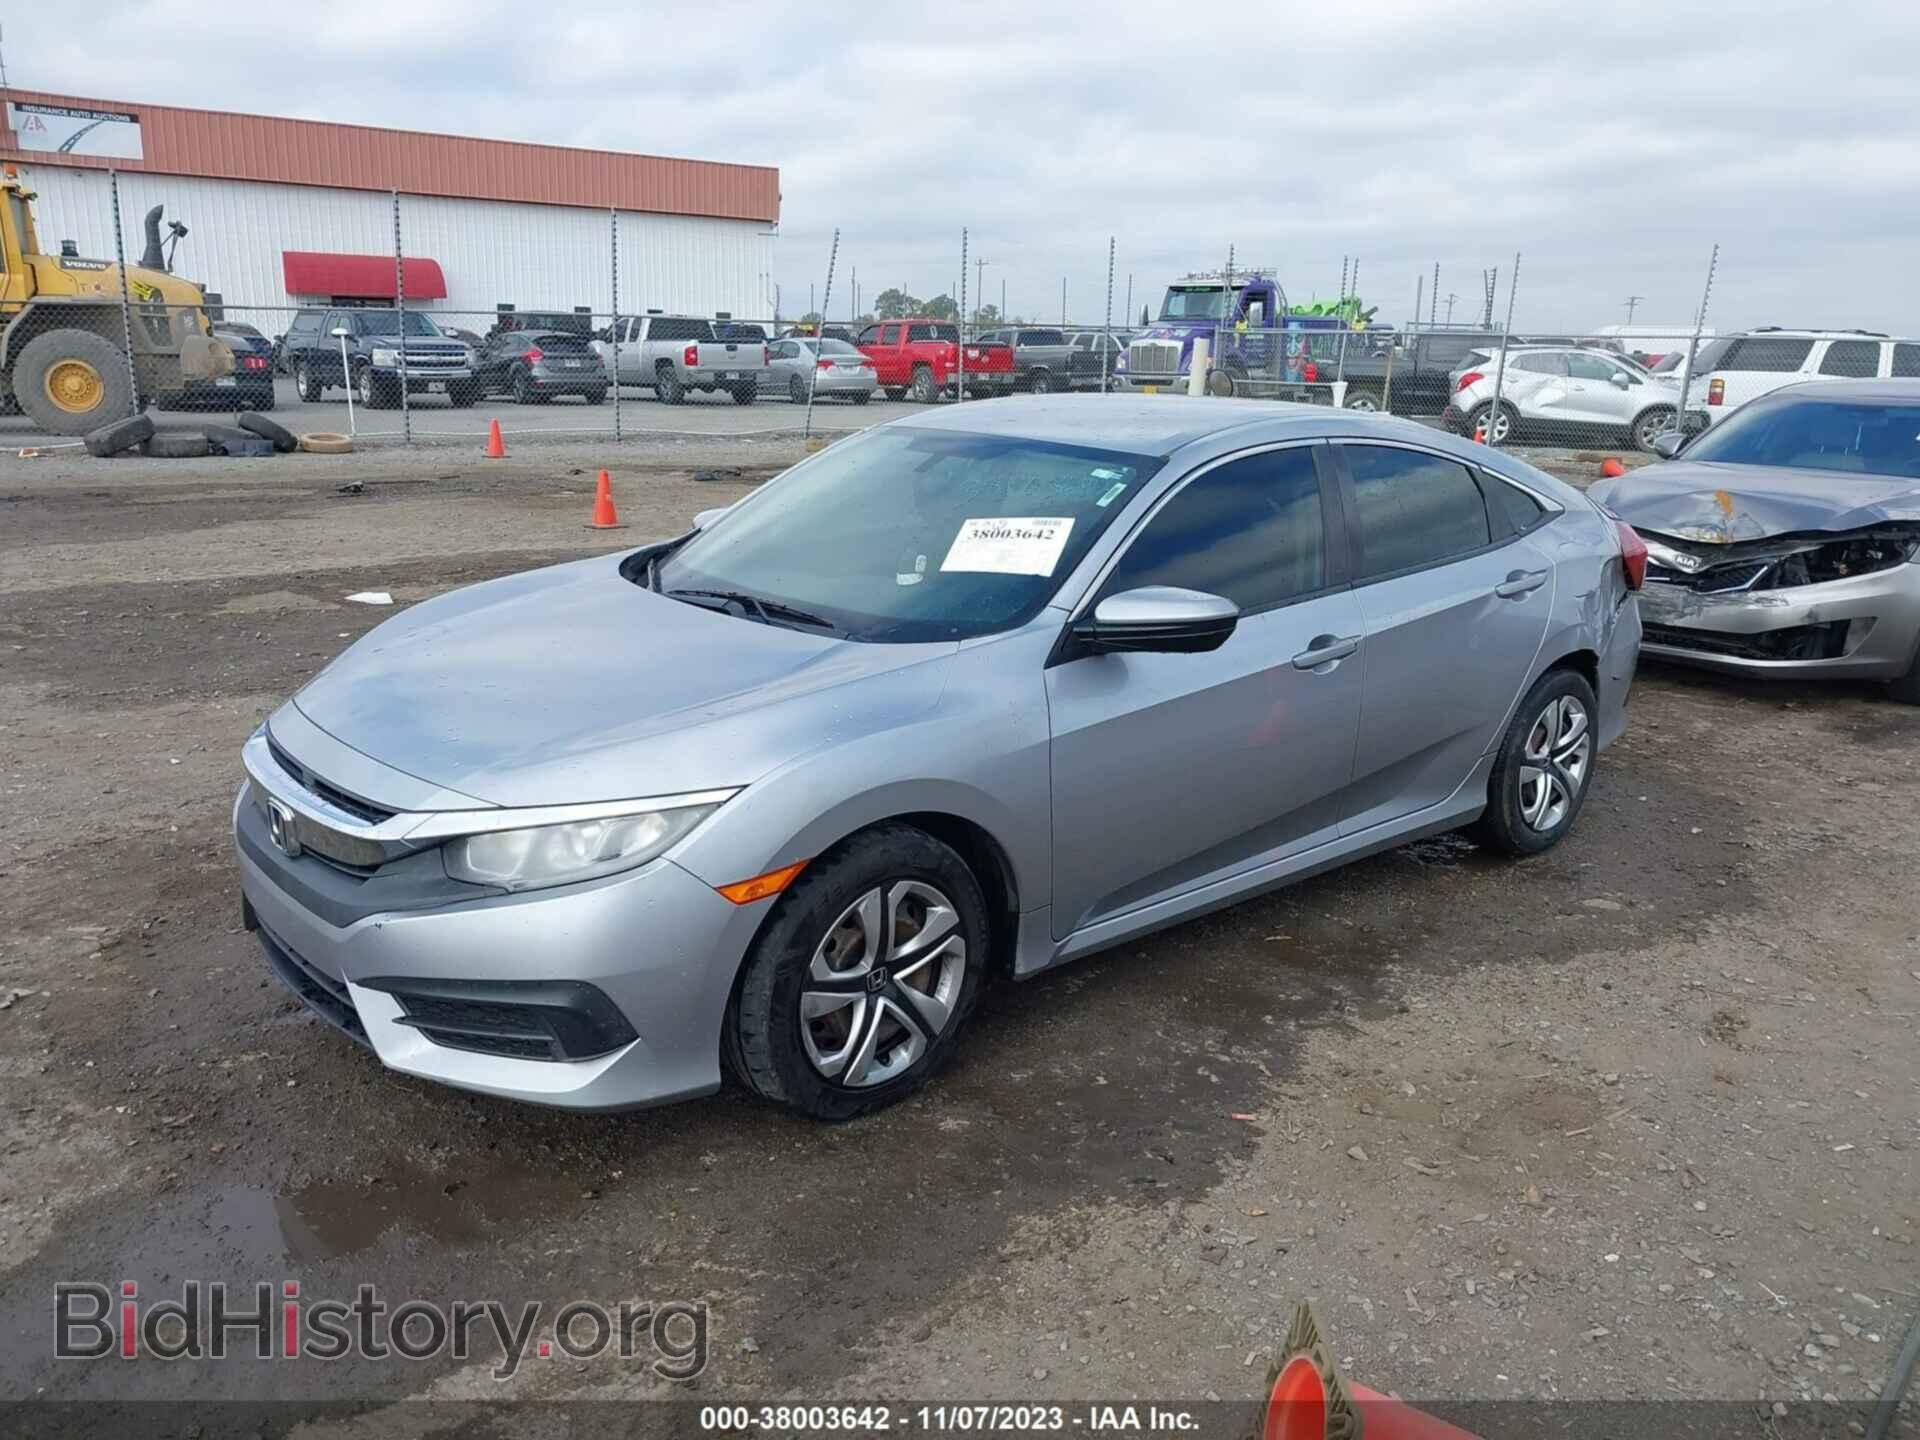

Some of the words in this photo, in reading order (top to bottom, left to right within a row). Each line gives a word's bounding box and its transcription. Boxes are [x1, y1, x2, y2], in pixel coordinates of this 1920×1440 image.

[70, 110, 91, 118] AUTO
[63, 261, 106, 270] VOLVO
[967, 528, 1056, 540] 38003642
[1676, 555, 1695, 567] KIA
